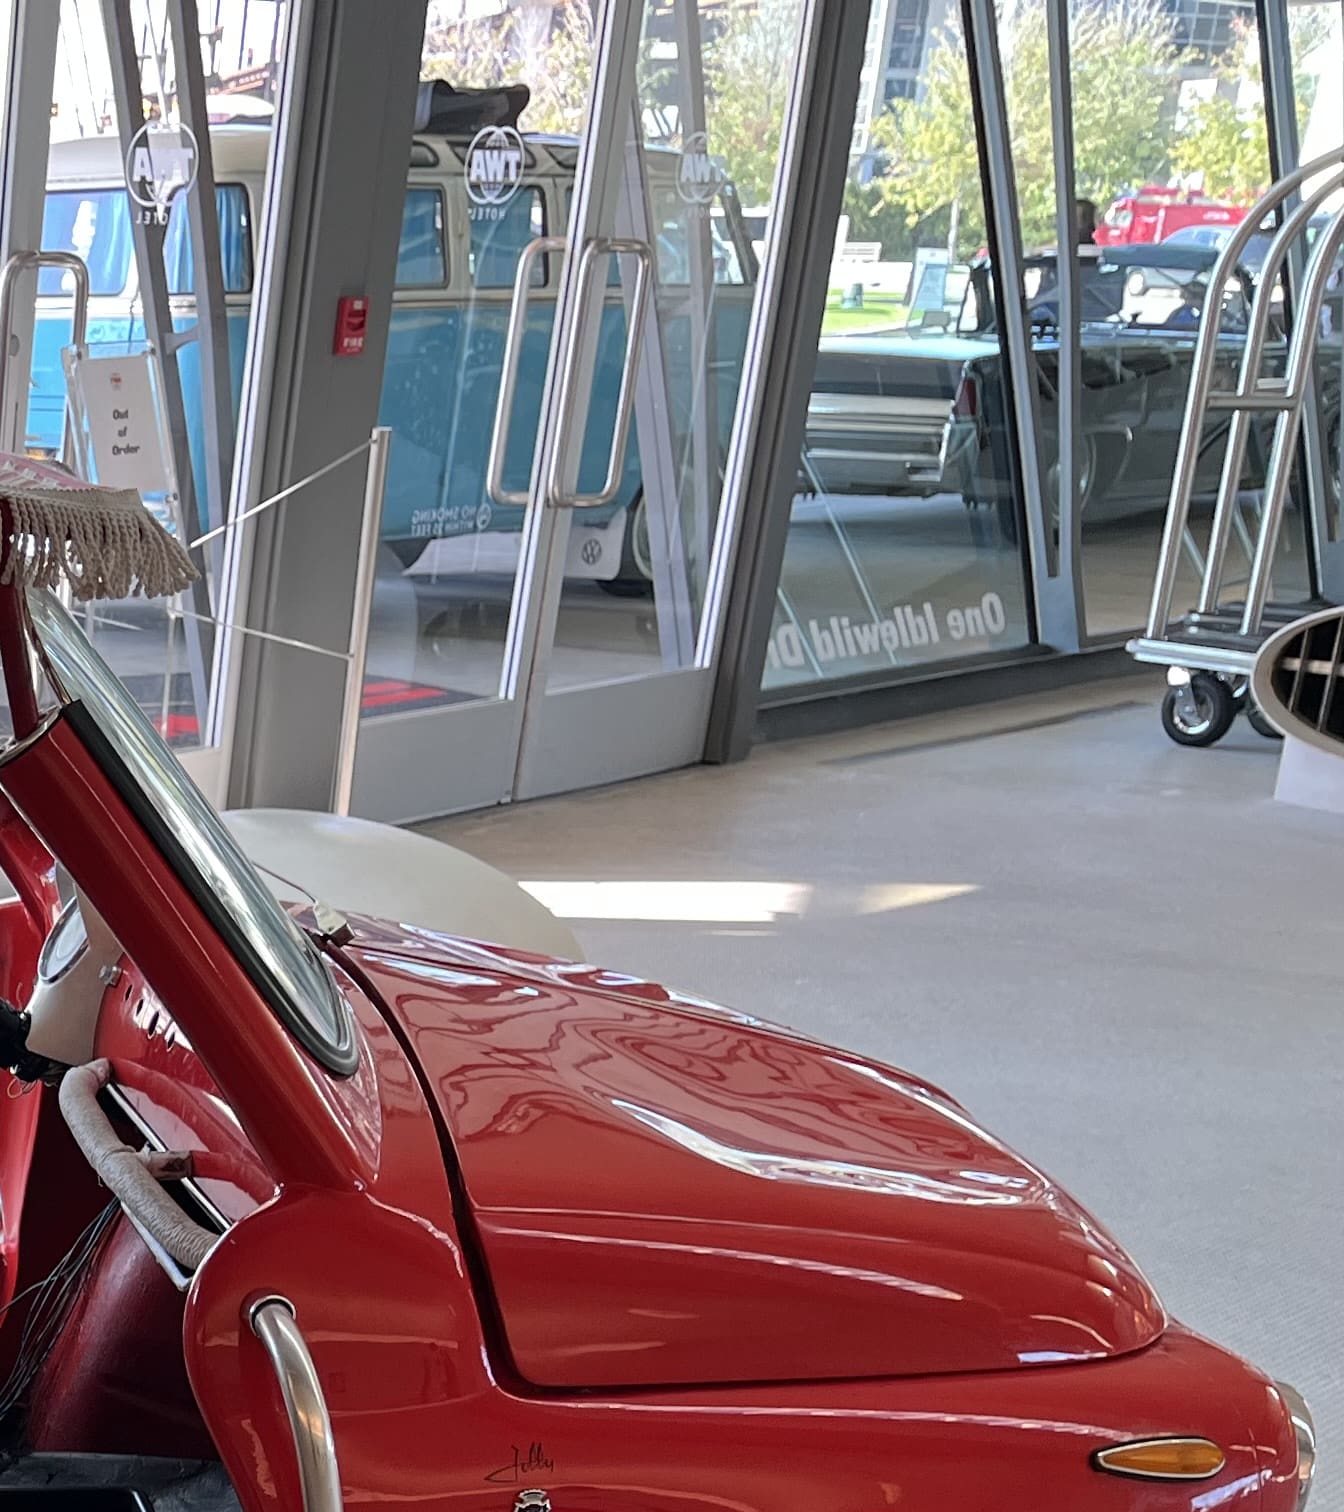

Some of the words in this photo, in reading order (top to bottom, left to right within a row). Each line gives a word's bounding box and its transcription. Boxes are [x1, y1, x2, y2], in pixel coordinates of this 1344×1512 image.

[113, 409, 129, 420] Out
[118, 426, 127, 437] of
[112, 443, 140, 455] Order
